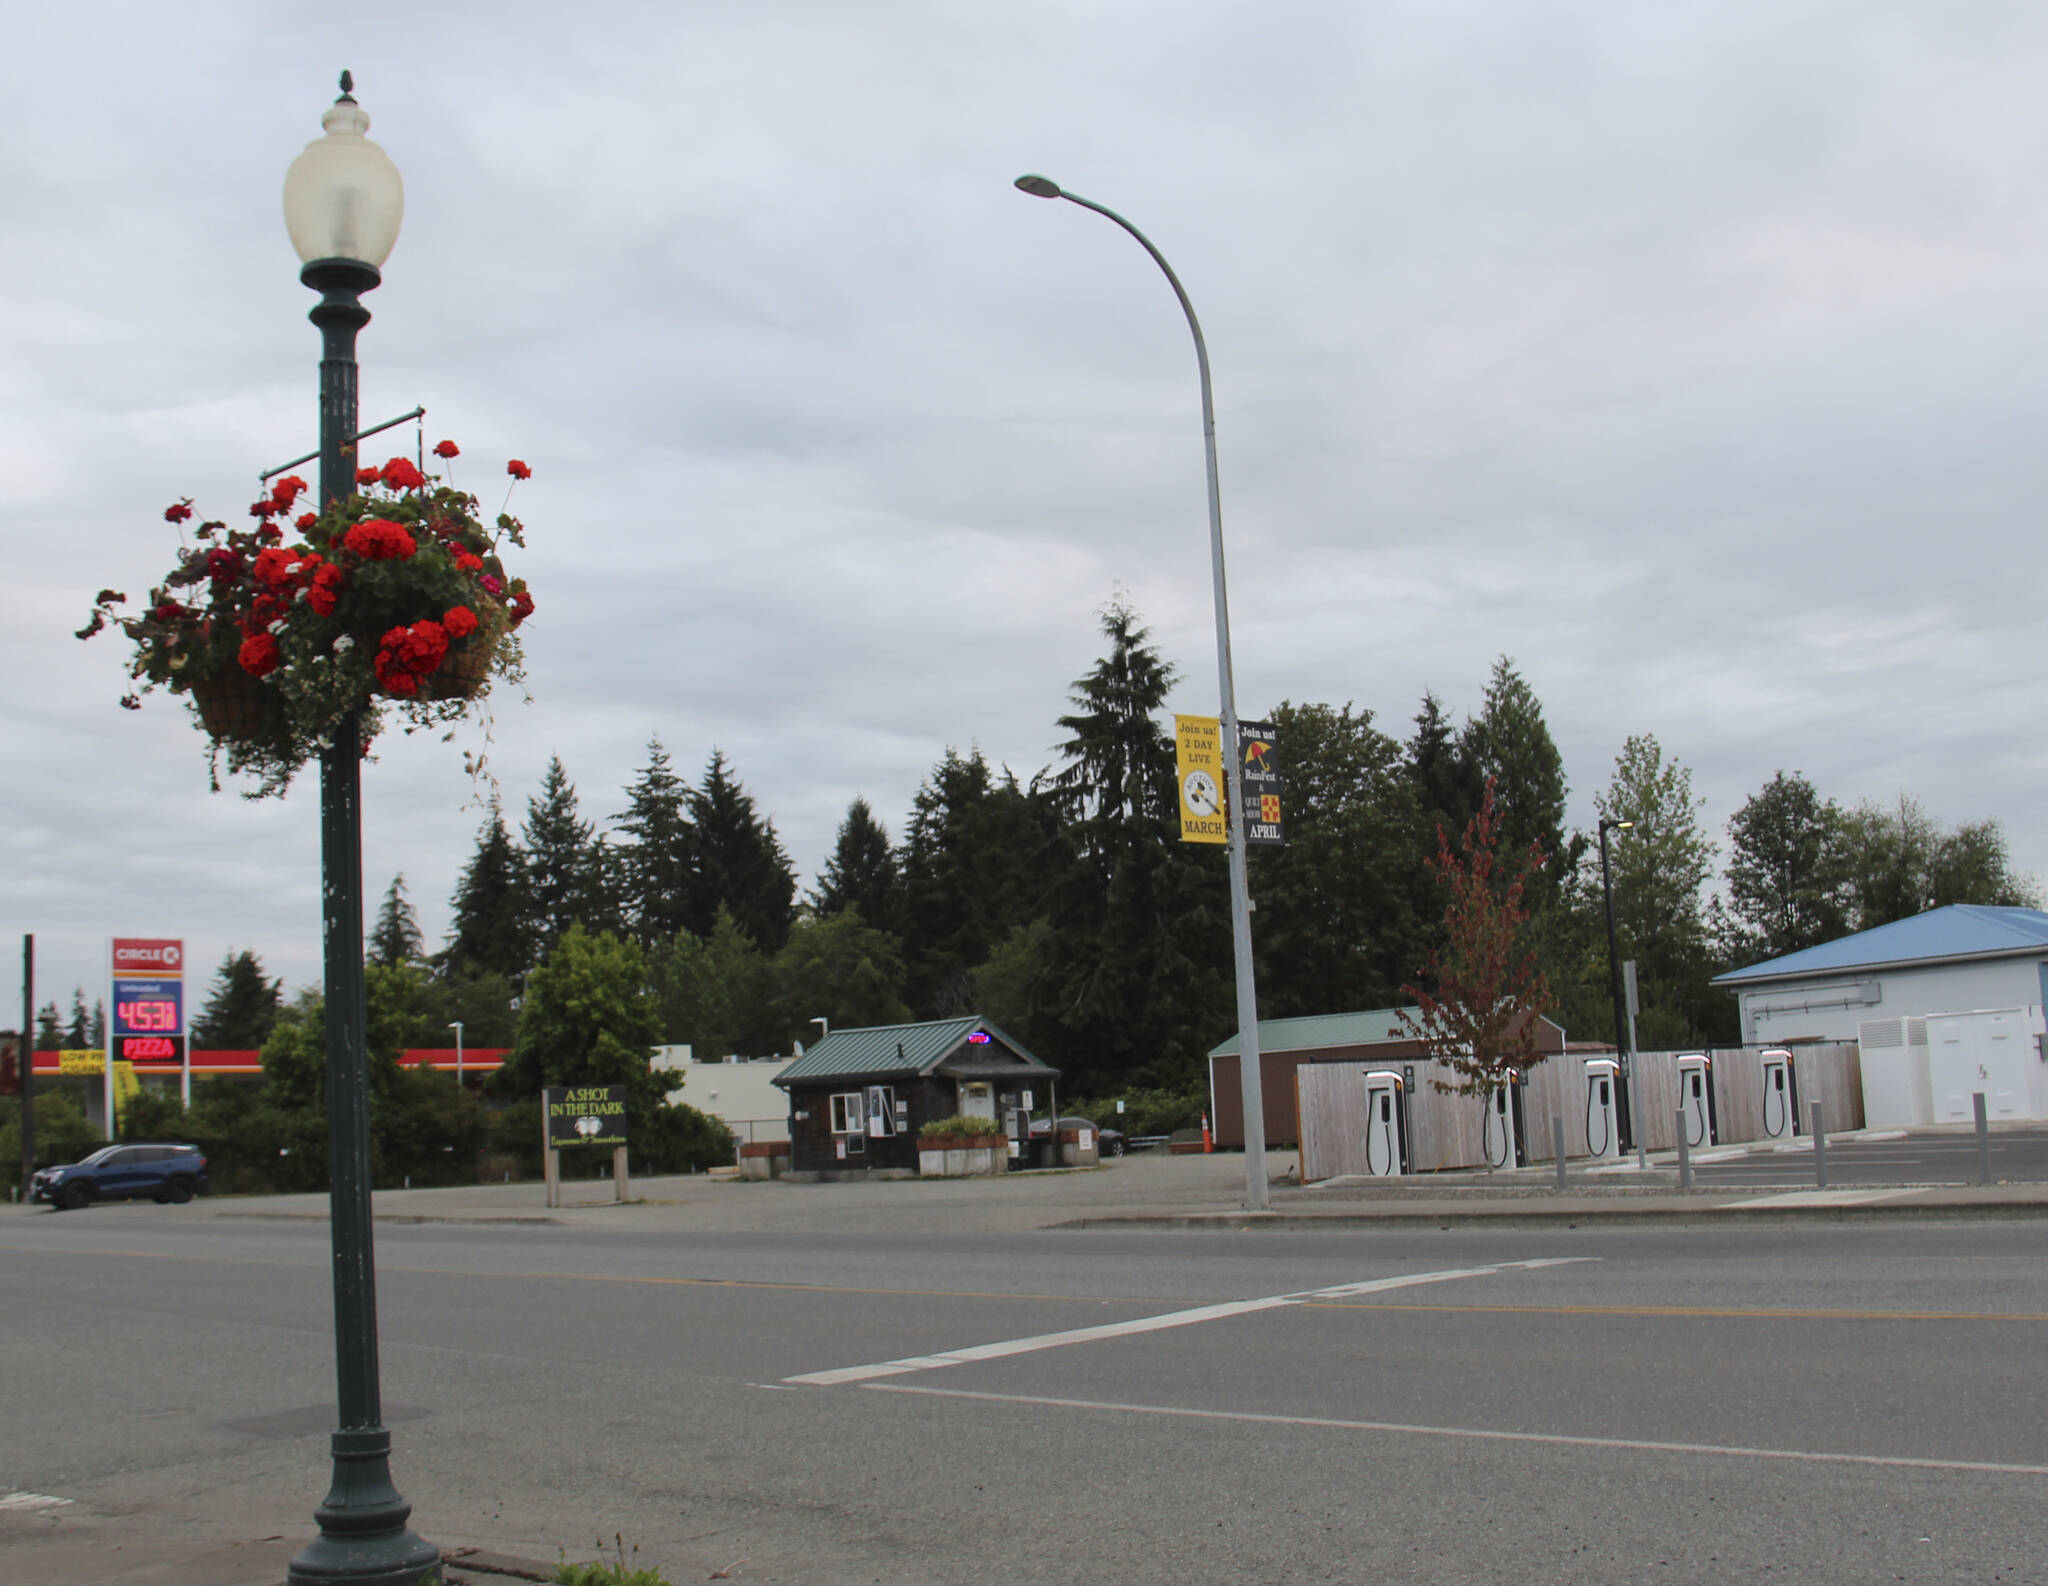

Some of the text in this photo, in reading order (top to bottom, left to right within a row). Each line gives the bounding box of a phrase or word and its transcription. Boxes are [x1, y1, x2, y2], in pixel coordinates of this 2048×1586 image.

[1179, 723, 1216, 736] Join us!
[1241, 727, 1276, 741] Join us!
[1184, 738, 1213, 750] 2 DAY
[1188, 753, 1211, 764] LIVE
[1245, 768, 1276, 782] RainFest
[1186, 774, 1214, 792] AUCTION
[1185, 820, 1223, 835] MARCH
[1250, 824, 1280, 839] APRIL
[116, 946, 180, 964] CIRCLE K
[123, 1038, 175, 1059] PIZZA
[565, 1088, 609, 1101] A SHOT
[551, 1102, 624, 1116] IN THE DARK
